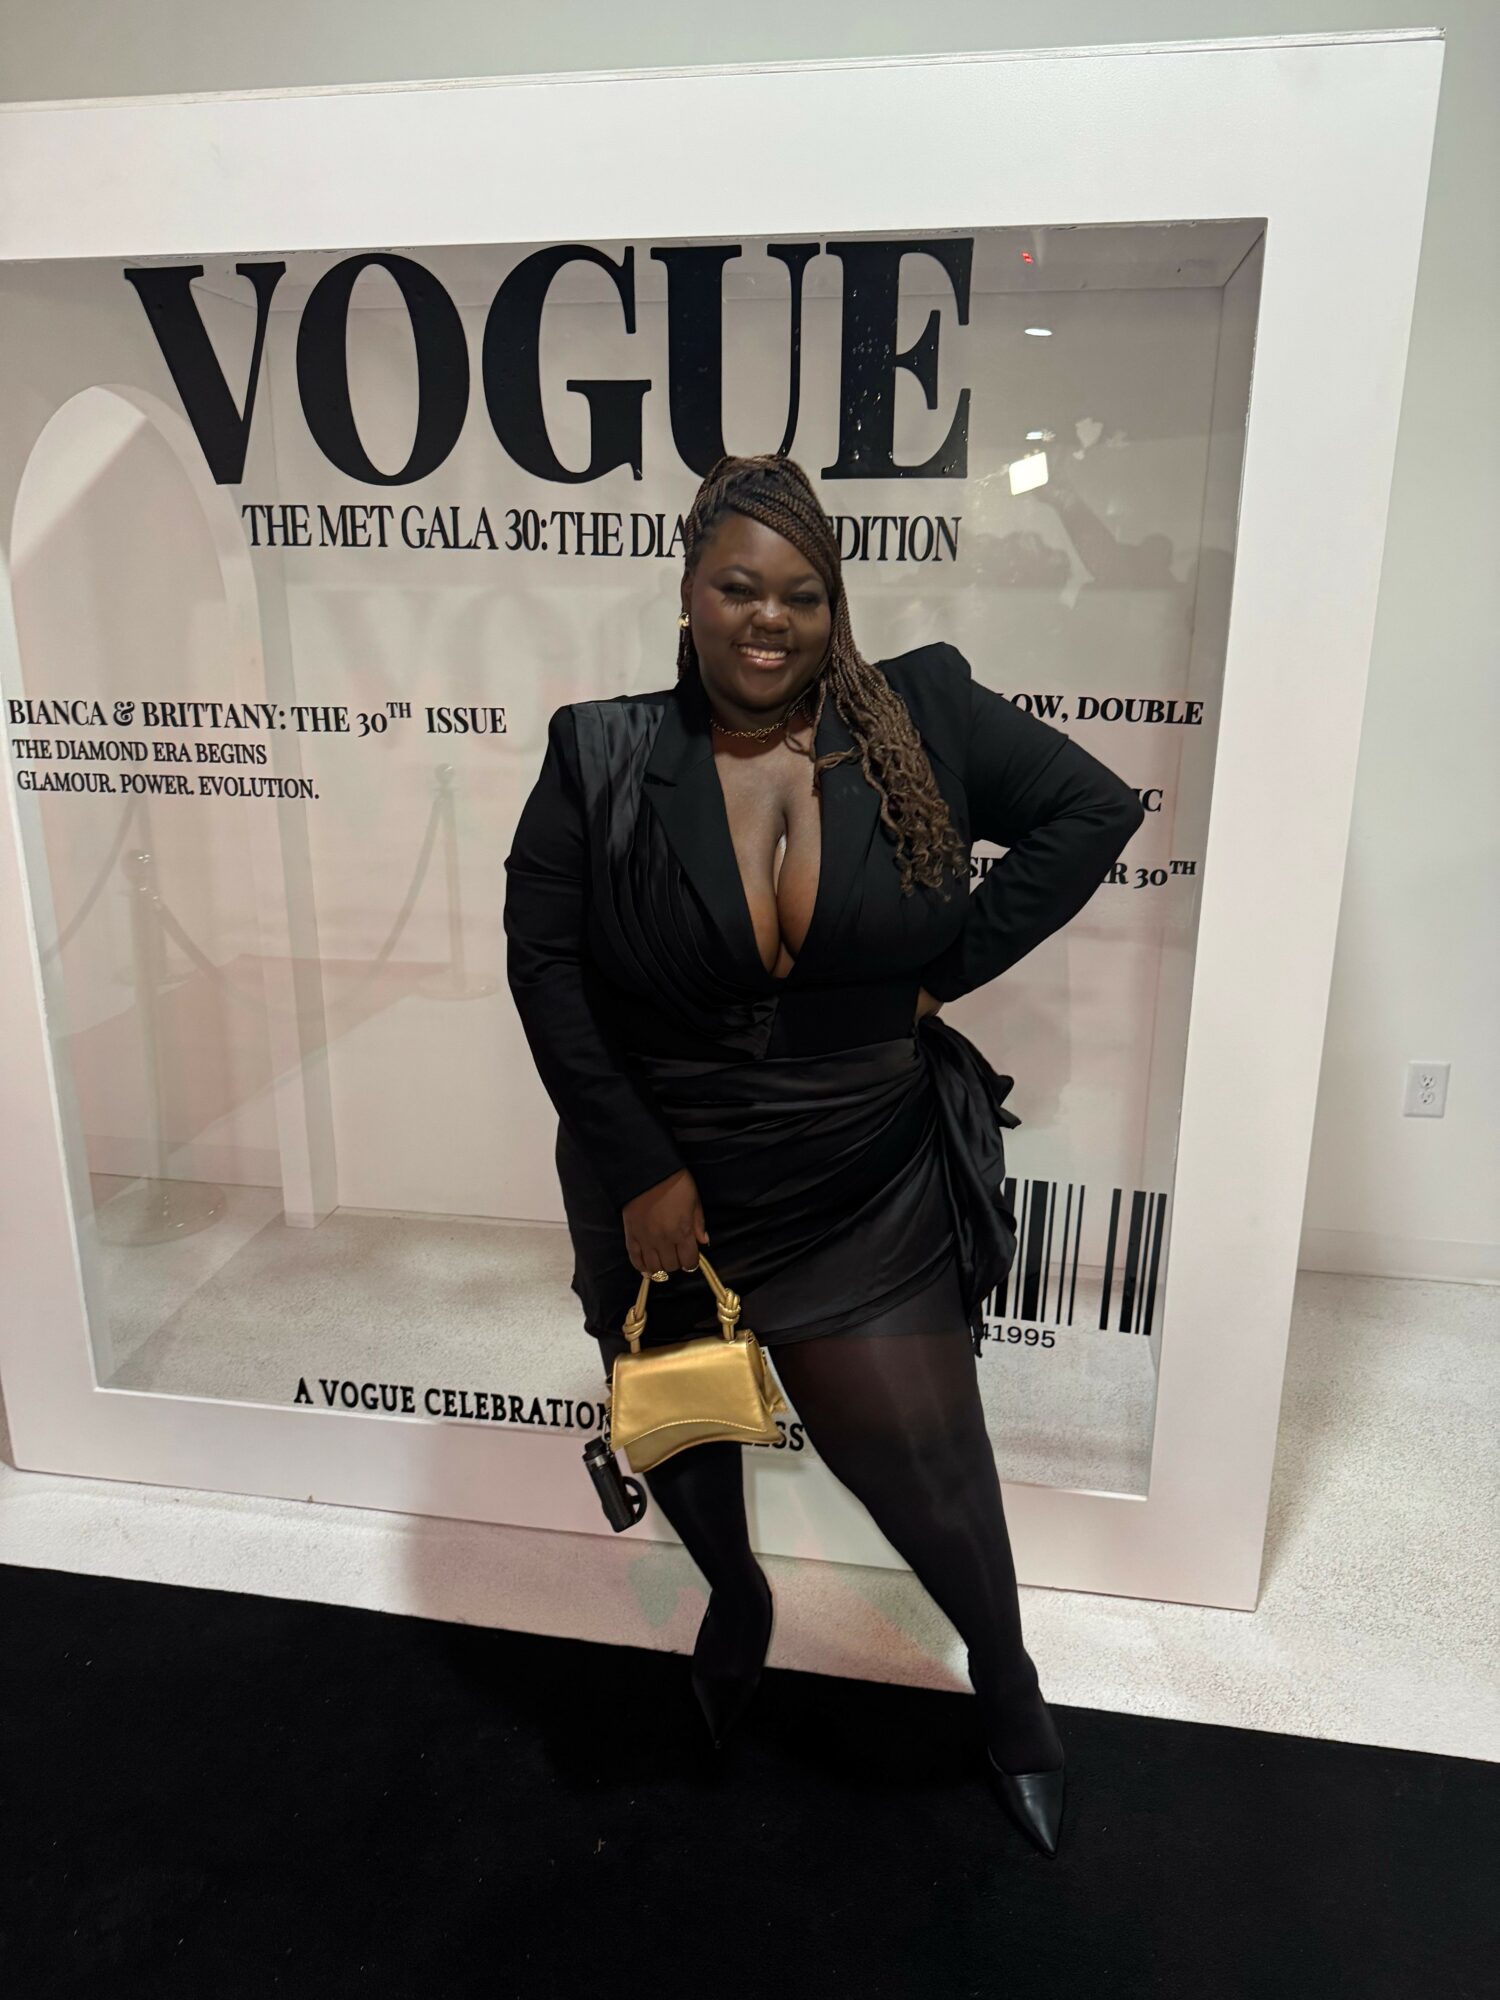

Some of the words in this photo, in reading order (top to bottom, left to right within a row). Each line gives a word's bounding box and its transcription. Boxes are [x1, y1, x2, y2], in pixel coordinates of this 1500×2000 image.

[124, 237, 974, 487] VOGUE
[241, 504, 313, 548] THE
[317, 504, 395, 548] MET
[401, 505, 499, 551] GALA
[630, 513, 688, 559] DIA
[8, 699, 109, 727] BIANCA
[113, 700, 135, 727] &
[142, 701, 287, 730] BRITTANY:
[291, 706, 351, 733] THE
[425, 707, 507, 734] ISSUE
[996, 693, 1069, 723] OW,
[1075, 696, 1205, 725] DOUBLE
[12, 738, 52, 760] THE
[55, 740, 149, 762] DIAMOND
[152, 741, 192, 764] ERA
[195, 743, 268, 765] BEGINS
[17, 770, 117, 794] GLAMOUR.
[121, 774, 195, 796] POWER.
[198, 775, 320, 800] EVOLUTION.
[293, 1376, 314, 1405] A
[318, 1378, 416, 1413] VOGUE
